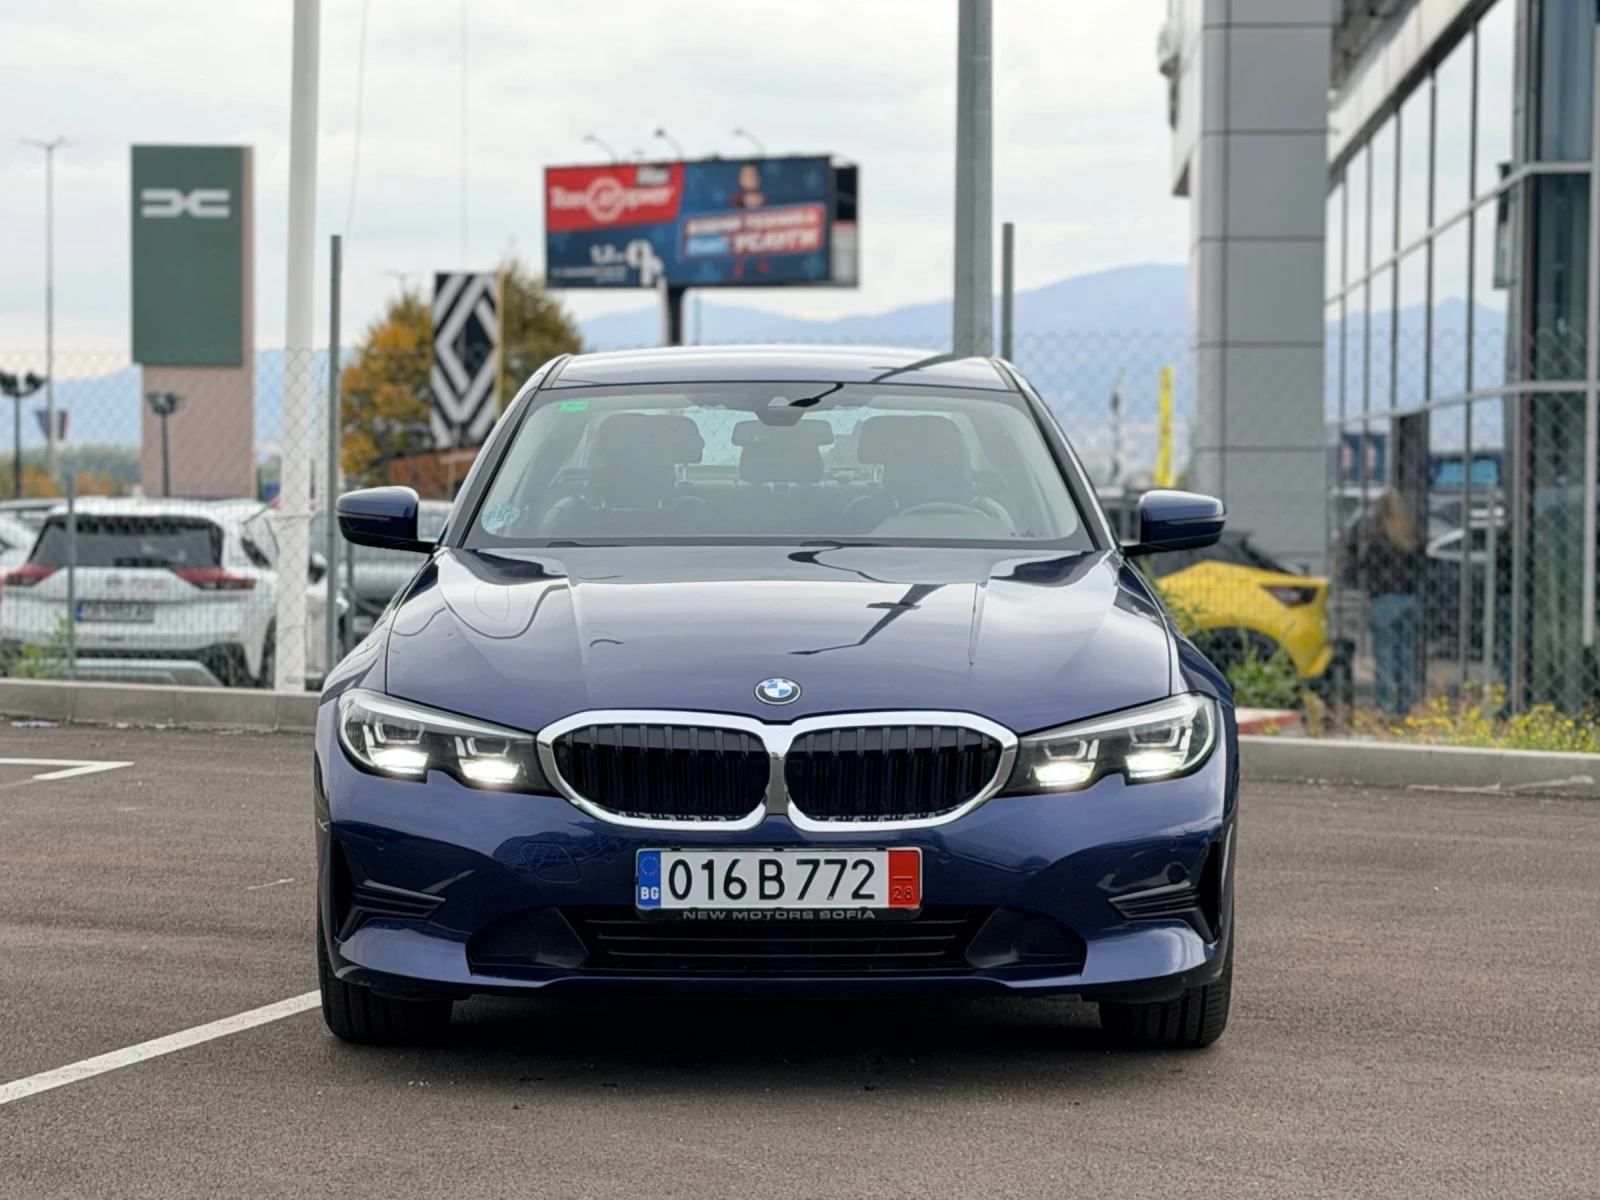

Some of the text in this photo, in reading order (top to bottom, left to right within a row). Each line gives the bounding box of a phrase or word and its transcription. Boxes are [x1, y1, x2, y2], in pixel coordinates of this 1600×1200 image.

[640, 886, 660, 900] BG
[892, 885, 913, 901] 28
[683, 910, 876, 920] NEW MOTORS SOFIA
